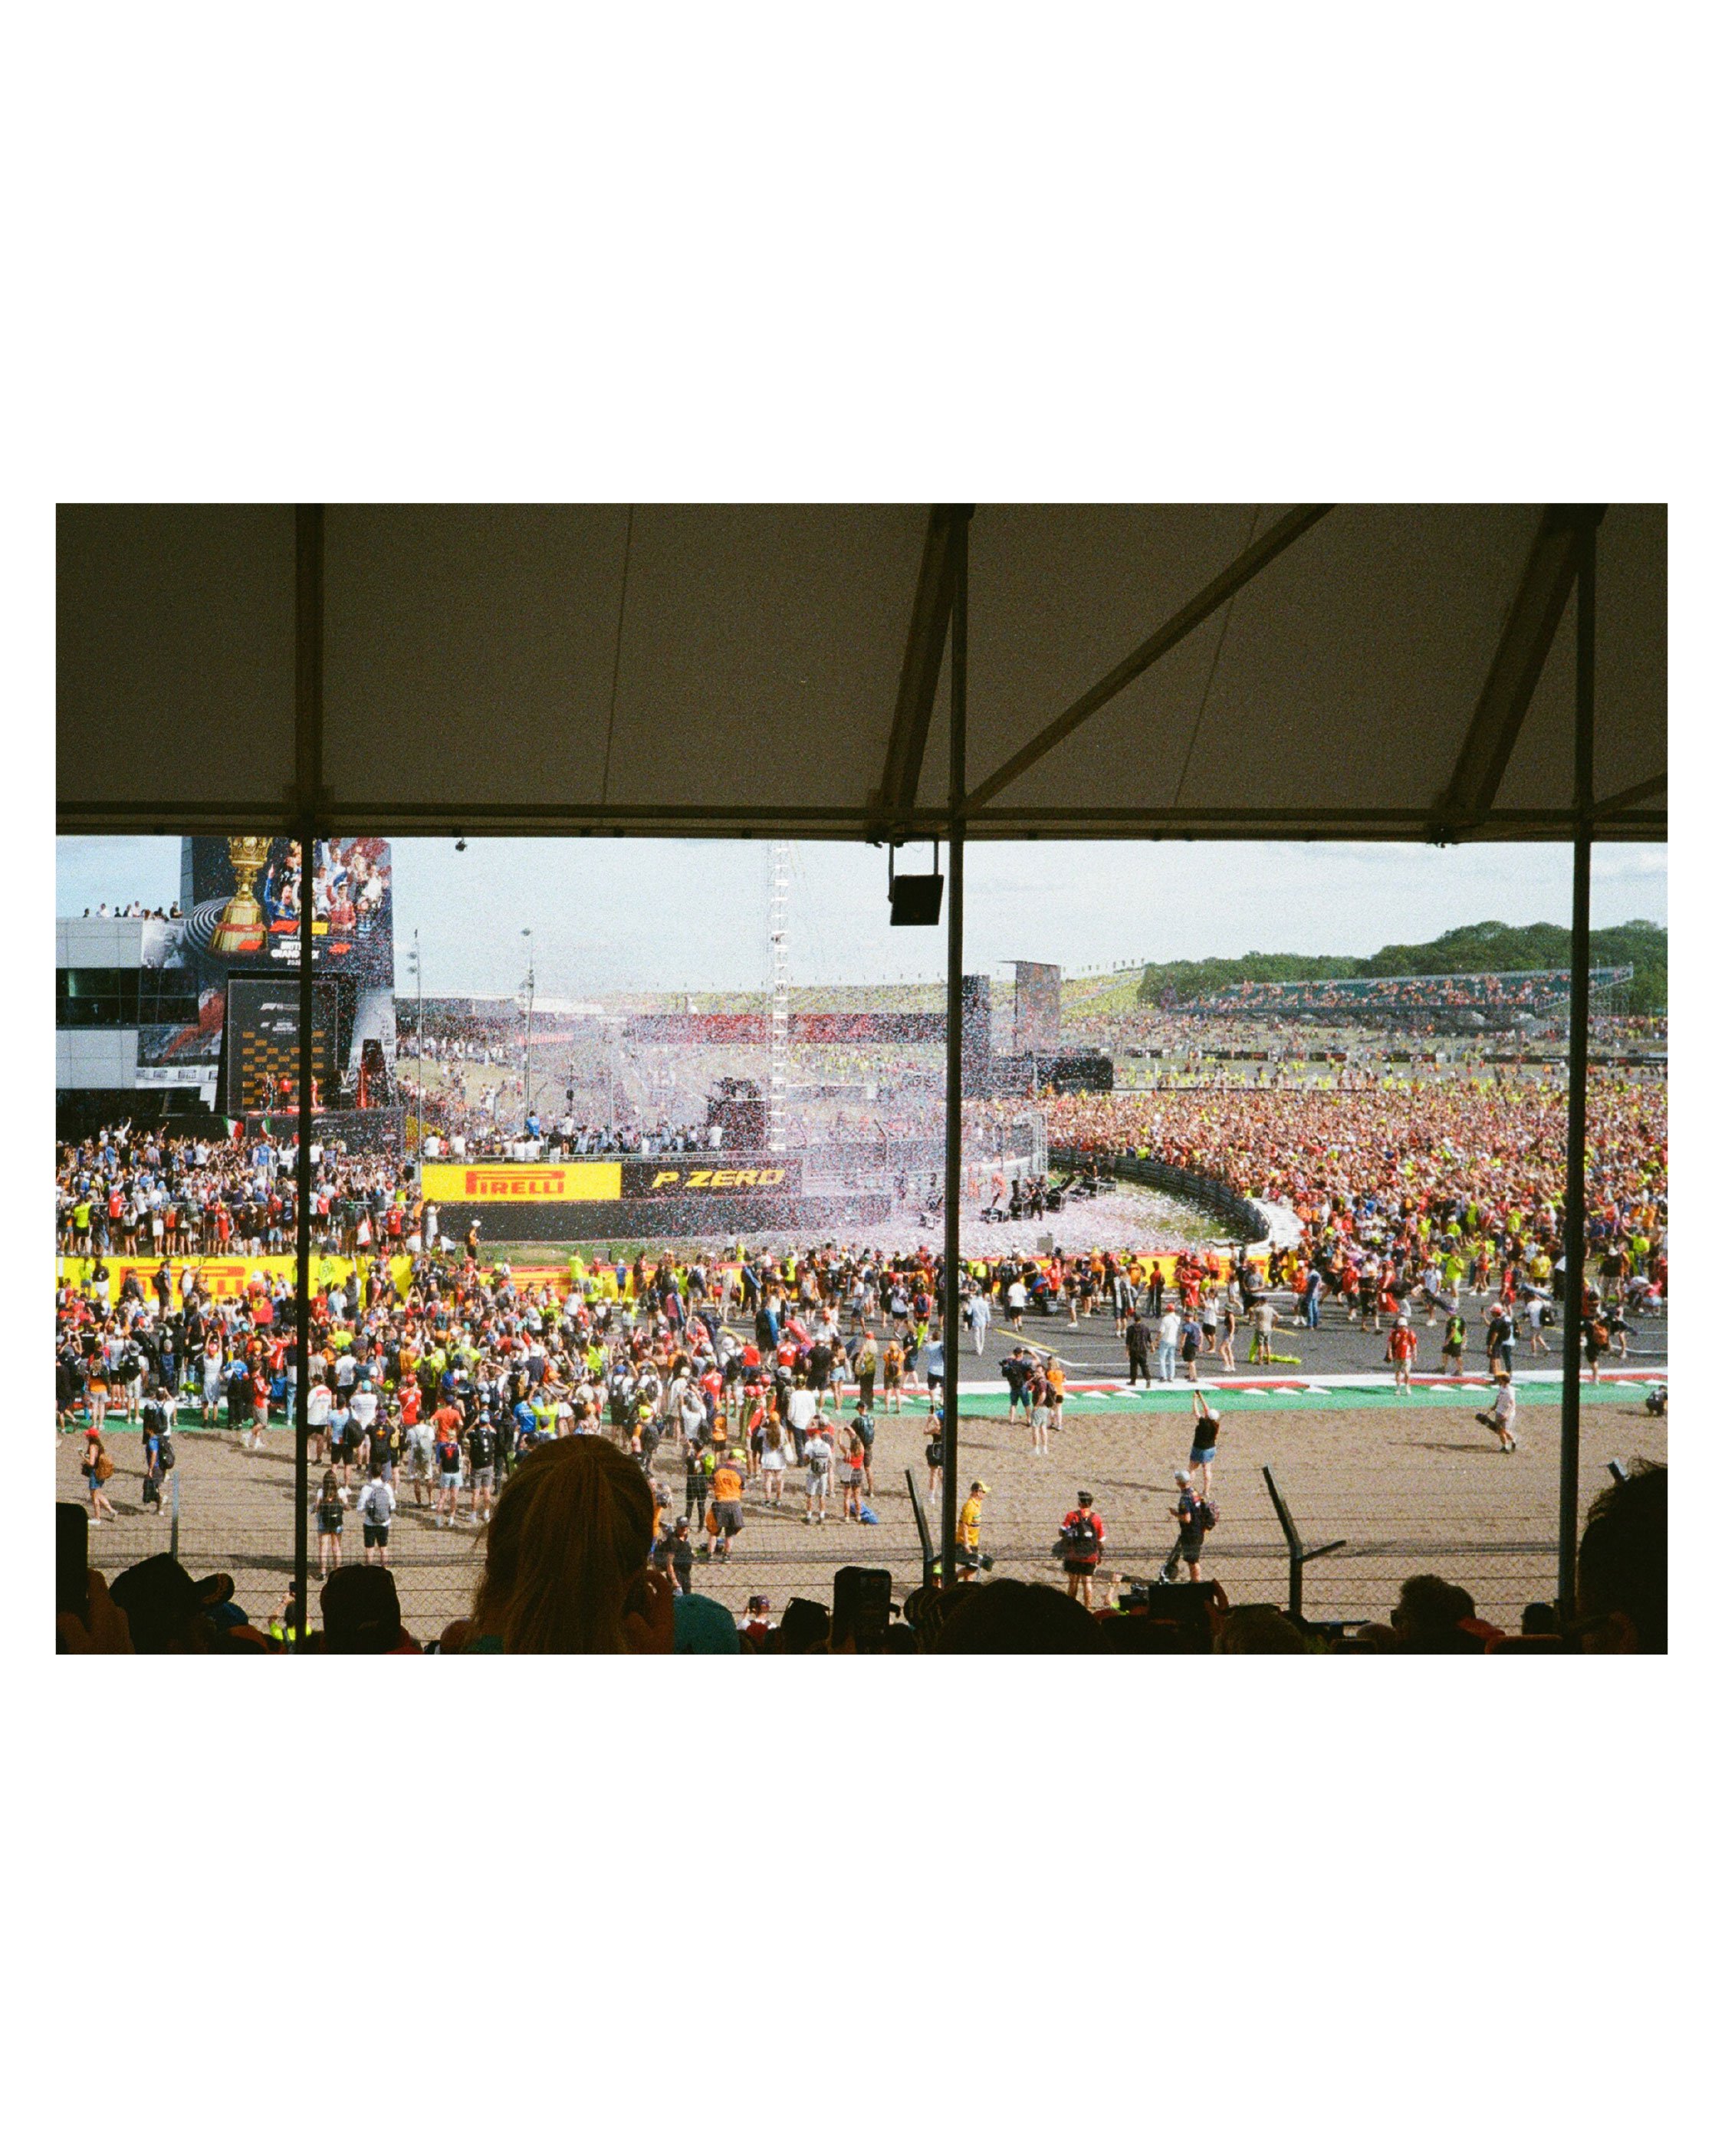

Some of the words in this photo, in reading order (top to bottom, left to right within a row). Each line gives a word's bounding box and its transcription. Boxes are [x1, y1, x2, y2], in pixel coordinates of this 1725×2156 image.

[465, 1171, 565, 1194] PIRELLI
[652, 1172, 679, 1188] P
[685, 1170, 785, 1187] ZERO
